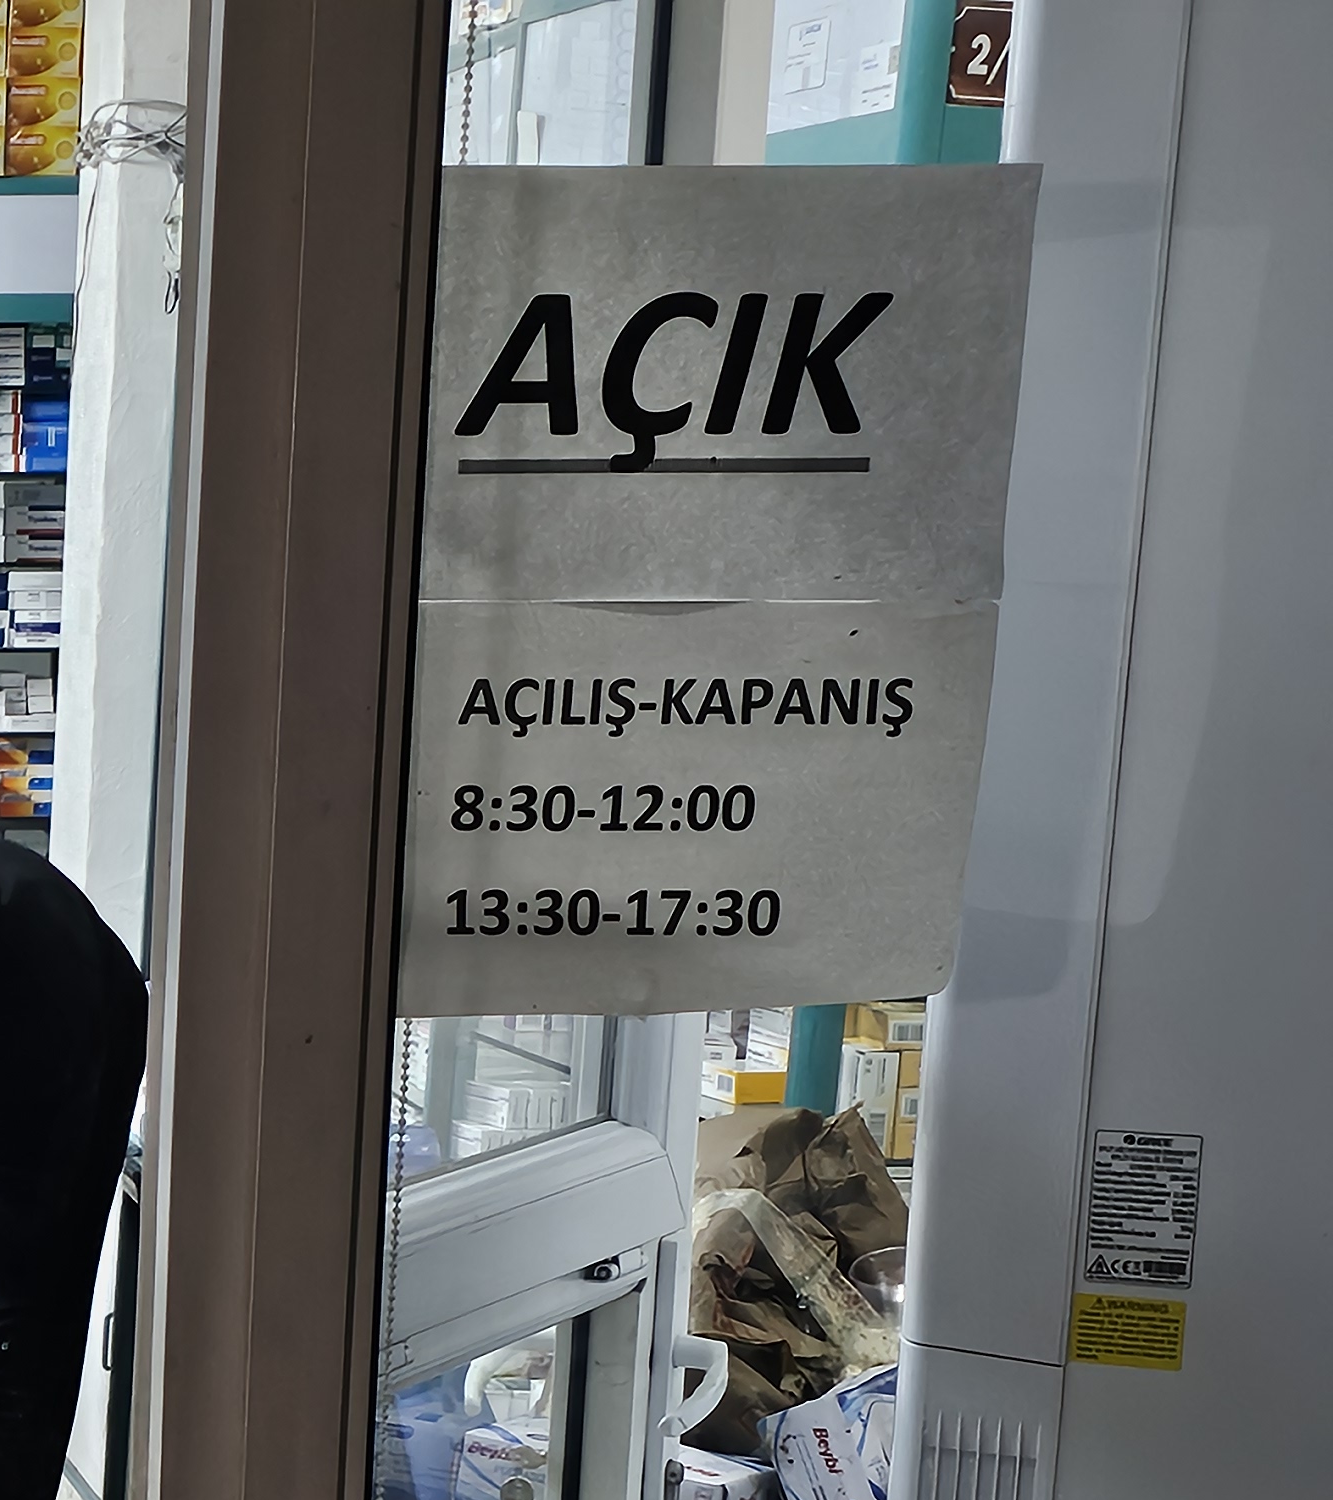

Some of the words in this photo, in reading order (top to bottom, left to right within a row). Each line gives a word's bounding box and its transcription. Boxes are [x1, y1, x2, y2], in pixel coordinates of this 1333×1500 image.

[454, 292, 894, 473] AÇIK
[458, 676, 914, 738] AÇILIŞ-KAPANIŞ
[450, 784, 756, 832] 8:30-12:00
[446, 888, 781, 936] 13:30-17:30
